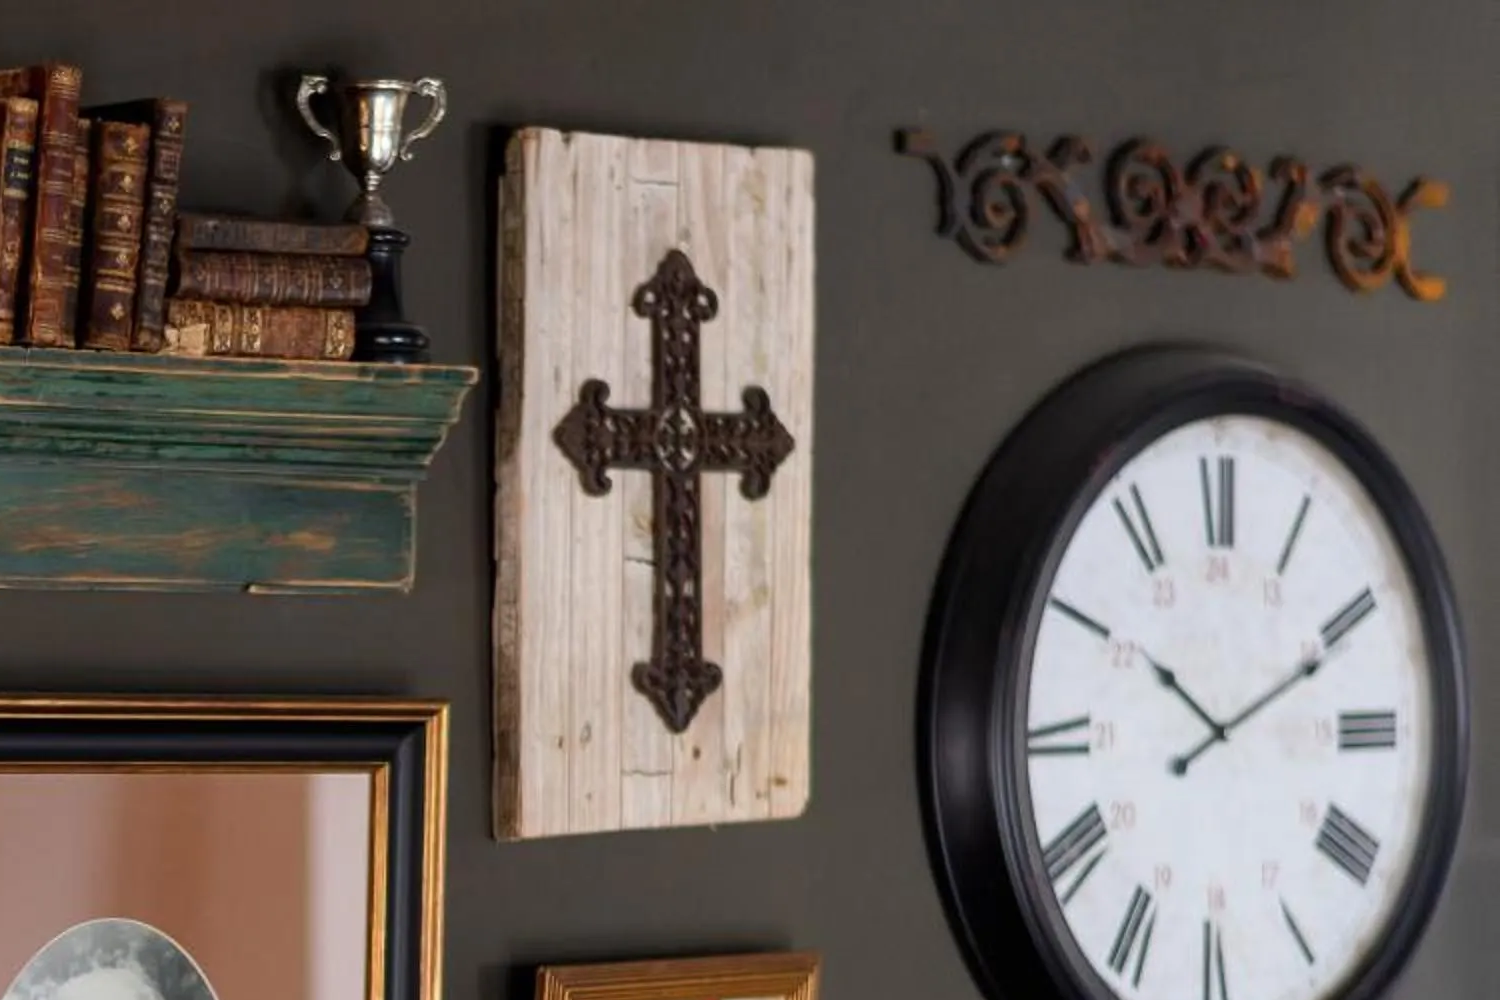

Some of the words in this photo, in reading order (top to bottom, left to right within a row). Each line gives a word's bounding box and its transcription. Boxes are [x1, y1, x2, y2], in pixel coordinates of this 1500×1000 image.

[1152, 577, 1176, 609] 23
[1110, 640, 1137, 669] 22
[1095, 720, 1114, 748] 21
[1110, 801, 1137, 830] 20
[1155, 865, 1173, 891] 19
